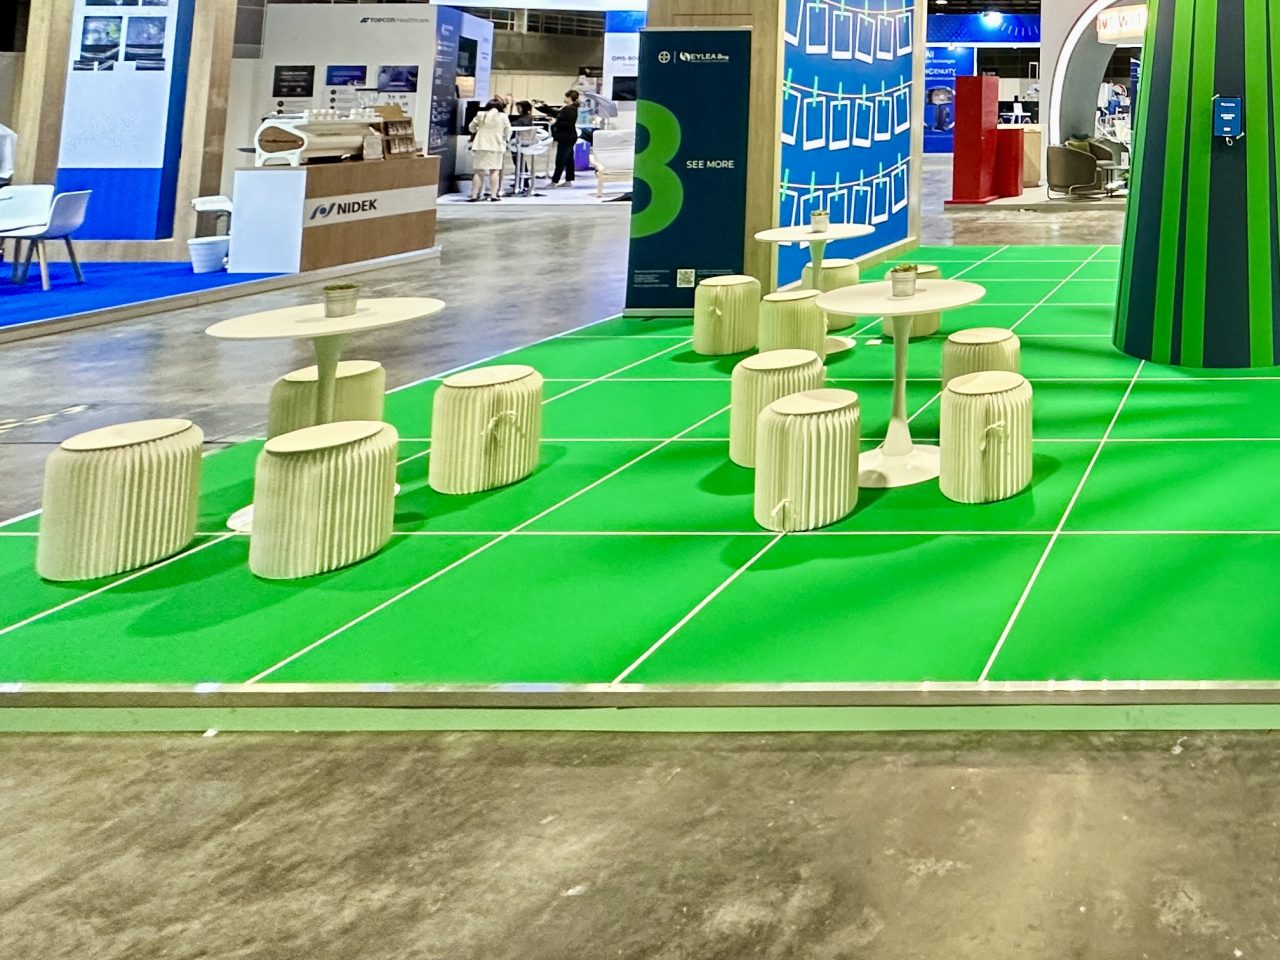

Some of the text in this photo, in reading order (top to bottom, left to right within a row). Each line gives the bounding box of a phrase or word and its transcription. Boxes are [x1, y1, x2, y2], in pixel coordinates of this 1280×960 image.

[690, 52, 717, 60] EYLEA
[686, 160, 735, 169] SEE MORE
[337, 198, 378, 215] NIDEK
